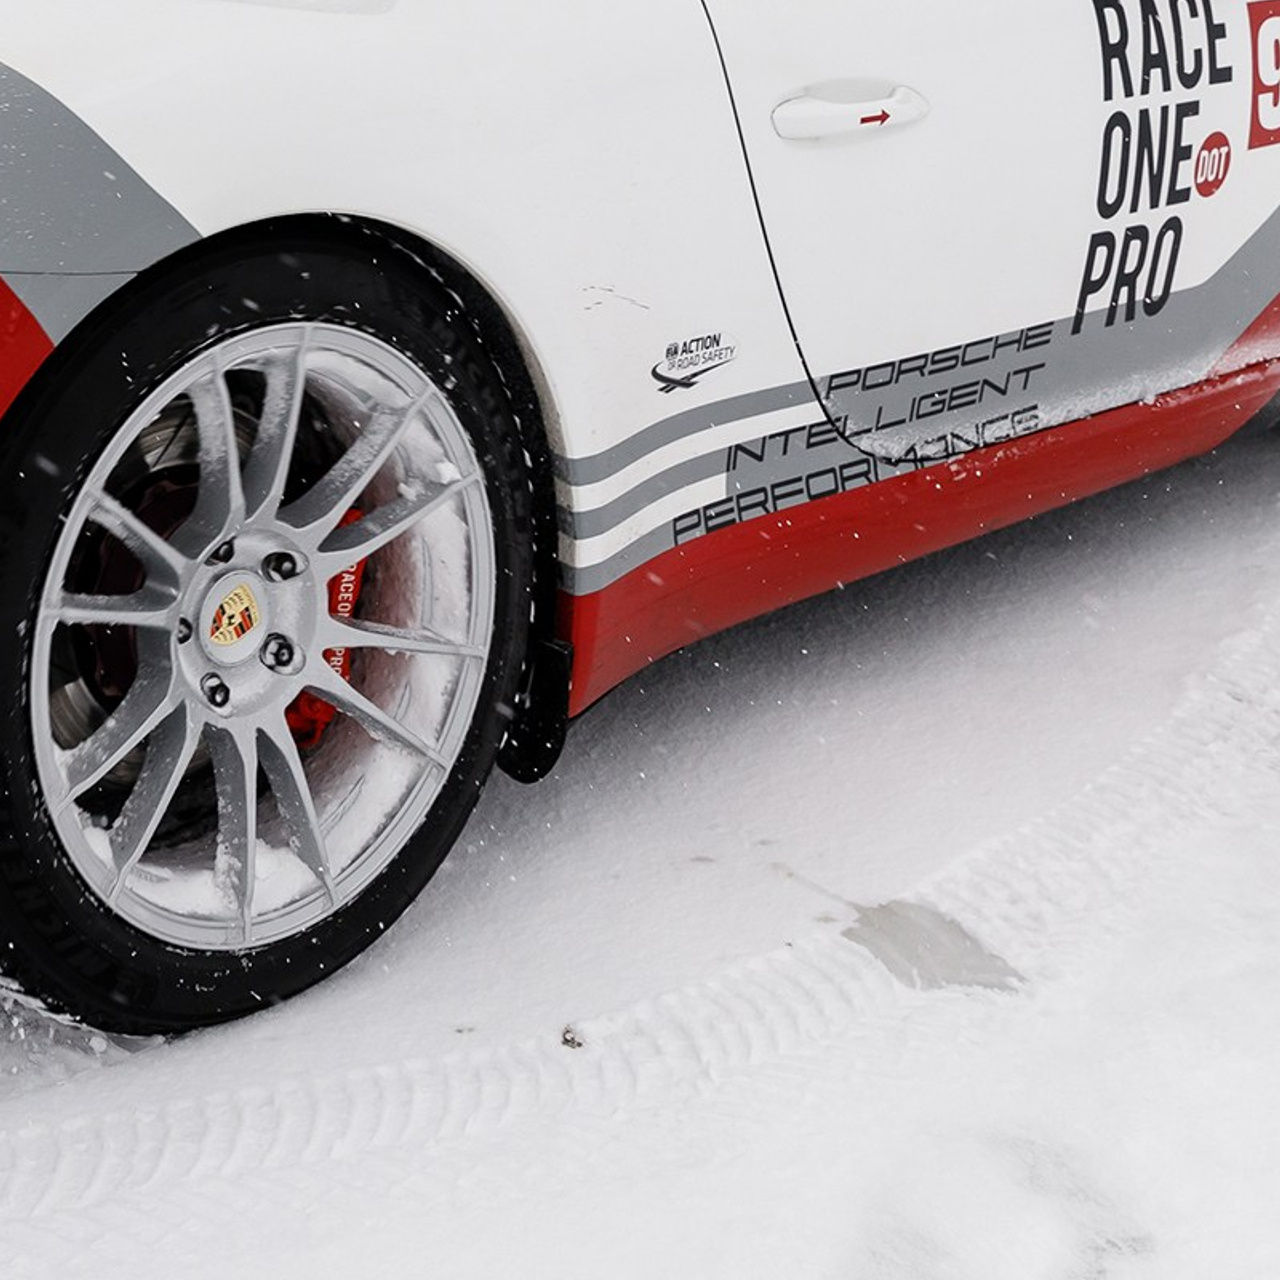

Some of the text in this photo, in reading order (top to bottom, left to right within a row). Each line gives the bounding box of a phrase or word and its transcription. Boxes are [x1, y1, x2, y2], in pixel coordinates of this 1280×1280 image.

[1095, 99, 1230, 220] ONE DOT
[1070, 215, 1184, 336] PRO
[677, 353, 701, 371] ROAD
[701, 345, 736, 365] SAFETY
[680, 332, 722, 357] ACTION
[824, 320, 1056, 400] PORSCHE
[725, 362, 1046, 472] INTELLIGENT
